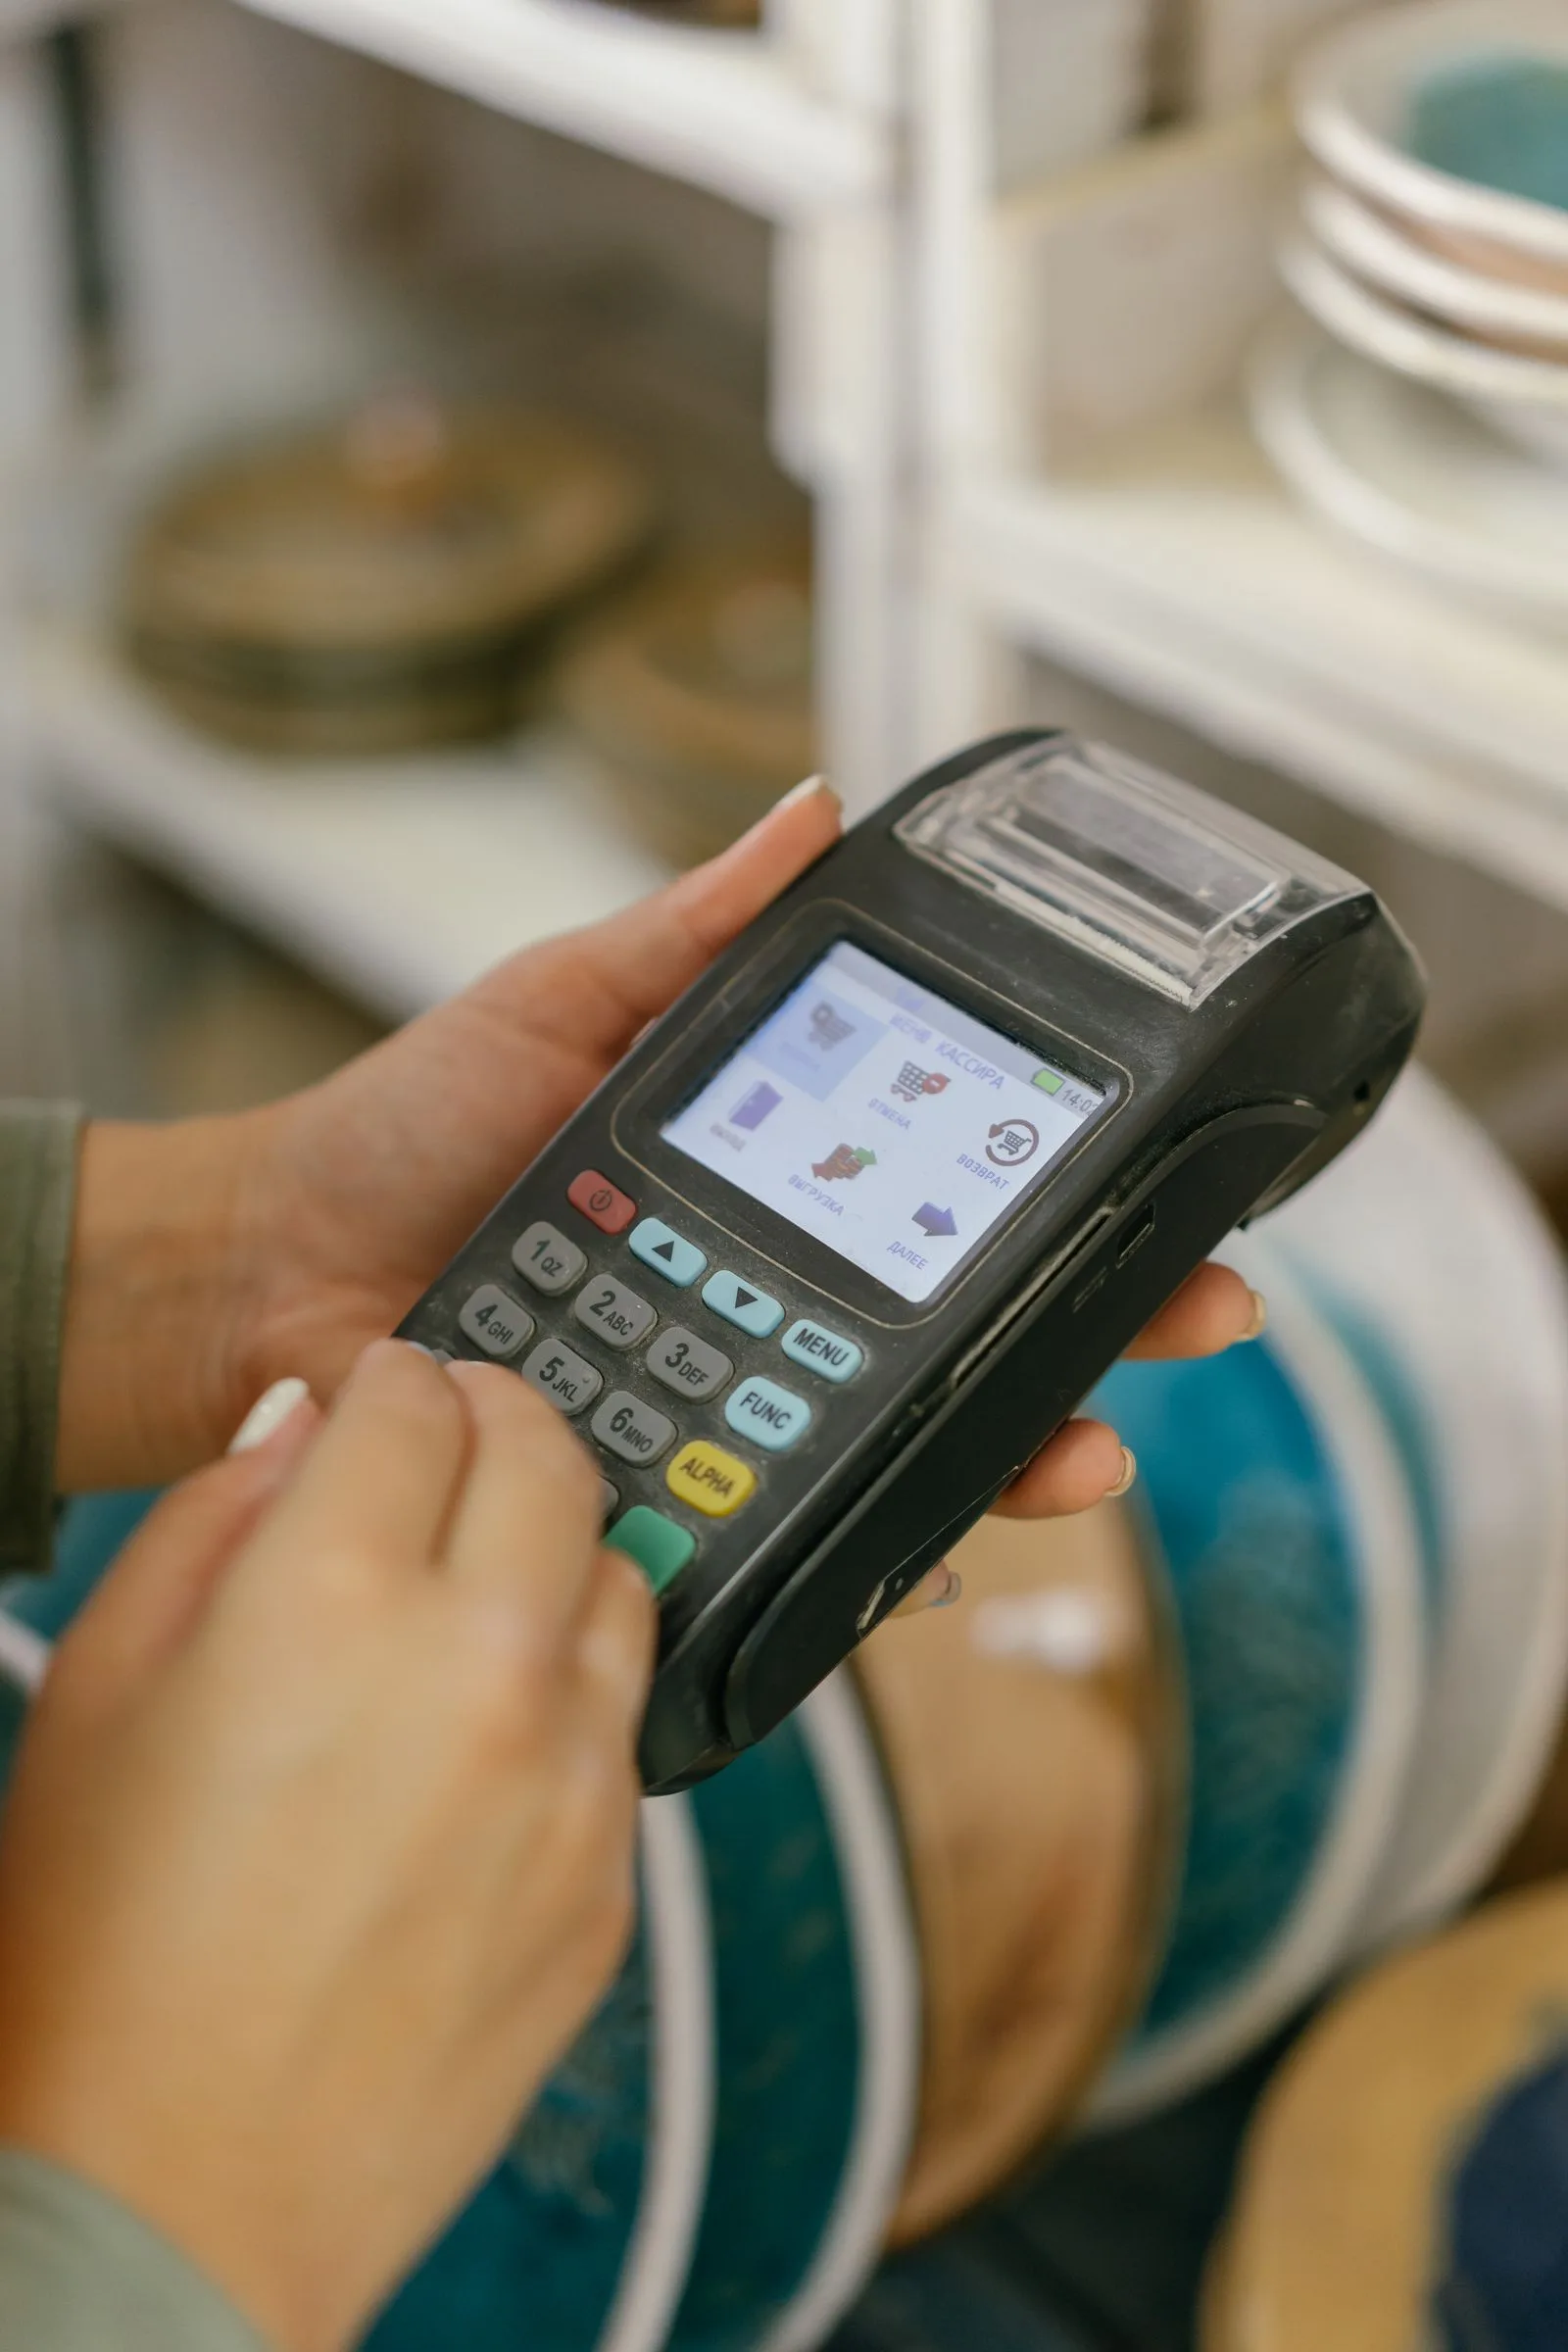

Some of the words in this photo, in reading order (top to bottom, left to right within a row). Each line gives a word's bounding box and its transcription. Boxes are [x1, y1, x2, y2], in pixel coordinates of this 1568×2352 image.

[935, 1040, 1006, 1090] КАССИРА
[956, 1153, 1009, 1191] ВОЗВРАТ
[788, 1174, 845, 1216] ВЫГРУЗКА
[886, 1241, 929, 1270] ДАЛЕЕ
[474, 1303, 499, 1327] 4
[487, 1320, 514, 1345] GHI
[589, 1291, 616, 1316] 2
[603, 1310, 633, 1336] ABC
[664, 1343, 689, 1368] 3
[679, 1363, 709, 1387] DEF
[792, 1328, 850, 1367] MENU
[539, 1356, 564, 1382] 5
[551, 1377, 578, 1402] JKL
[610, 1407, 634, 1433] 6
[623, 1425, 654, 1453] MNO
[740, 1392, 792, 1431] FUNC
[679, 1457, 736, 1497] ALPHA
